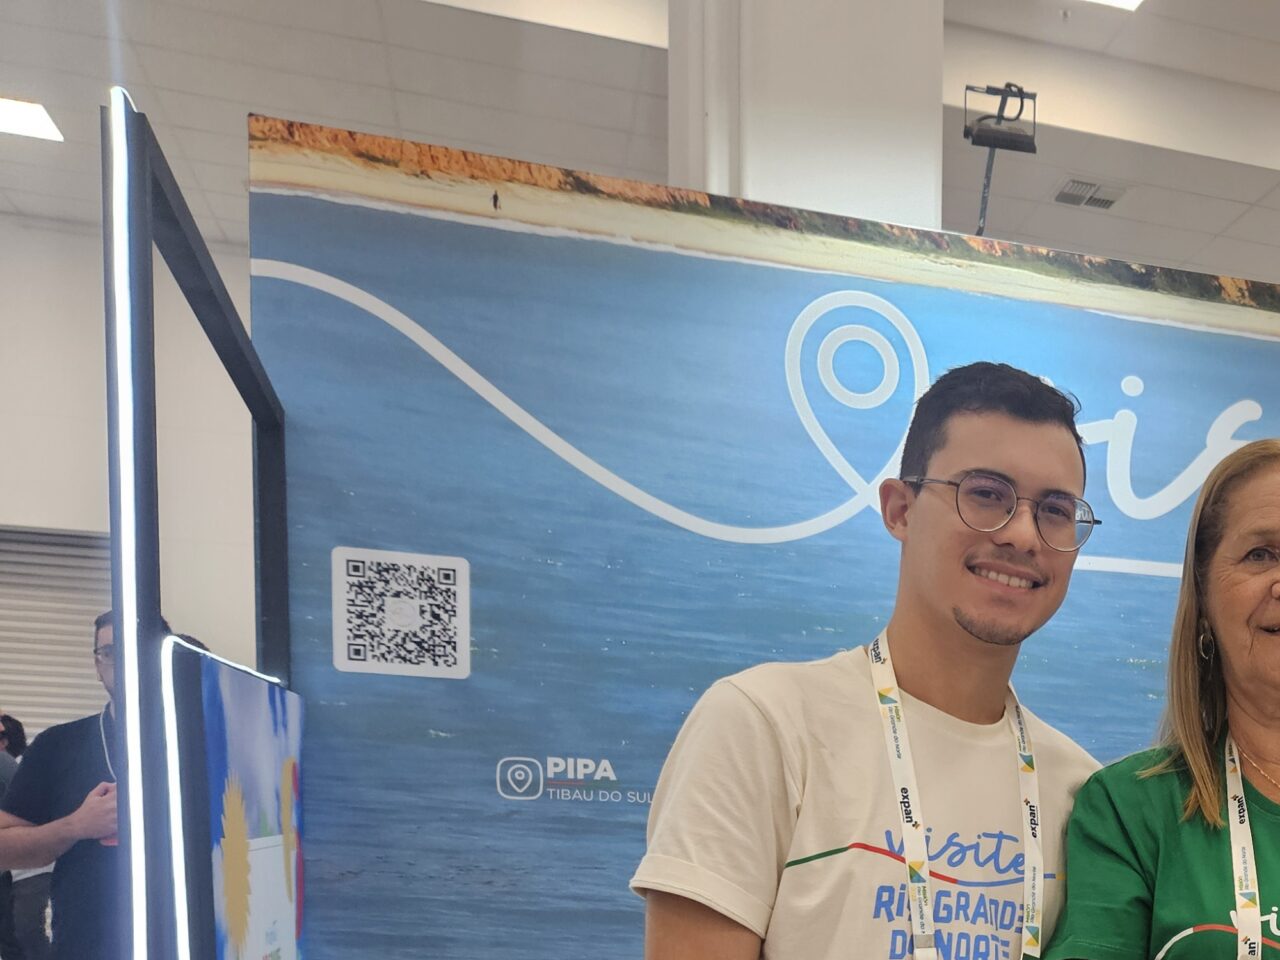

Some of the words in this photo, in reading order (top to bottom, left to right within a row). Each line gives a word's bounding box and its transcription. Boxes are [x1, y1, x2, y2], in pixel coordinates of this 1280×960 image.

[546, 756, 617, 781] PIPA
[546, 787, 594, 801] TIBAU
[599, 790, 622, 802] DO
[627, 791, 653, 804] SUL
[900, 787, 914, 824] expan
[1238, 796, 1247, 825] expan
[1029, 804, 1039, 839] expan
[873, 884, 911, 922] RI
